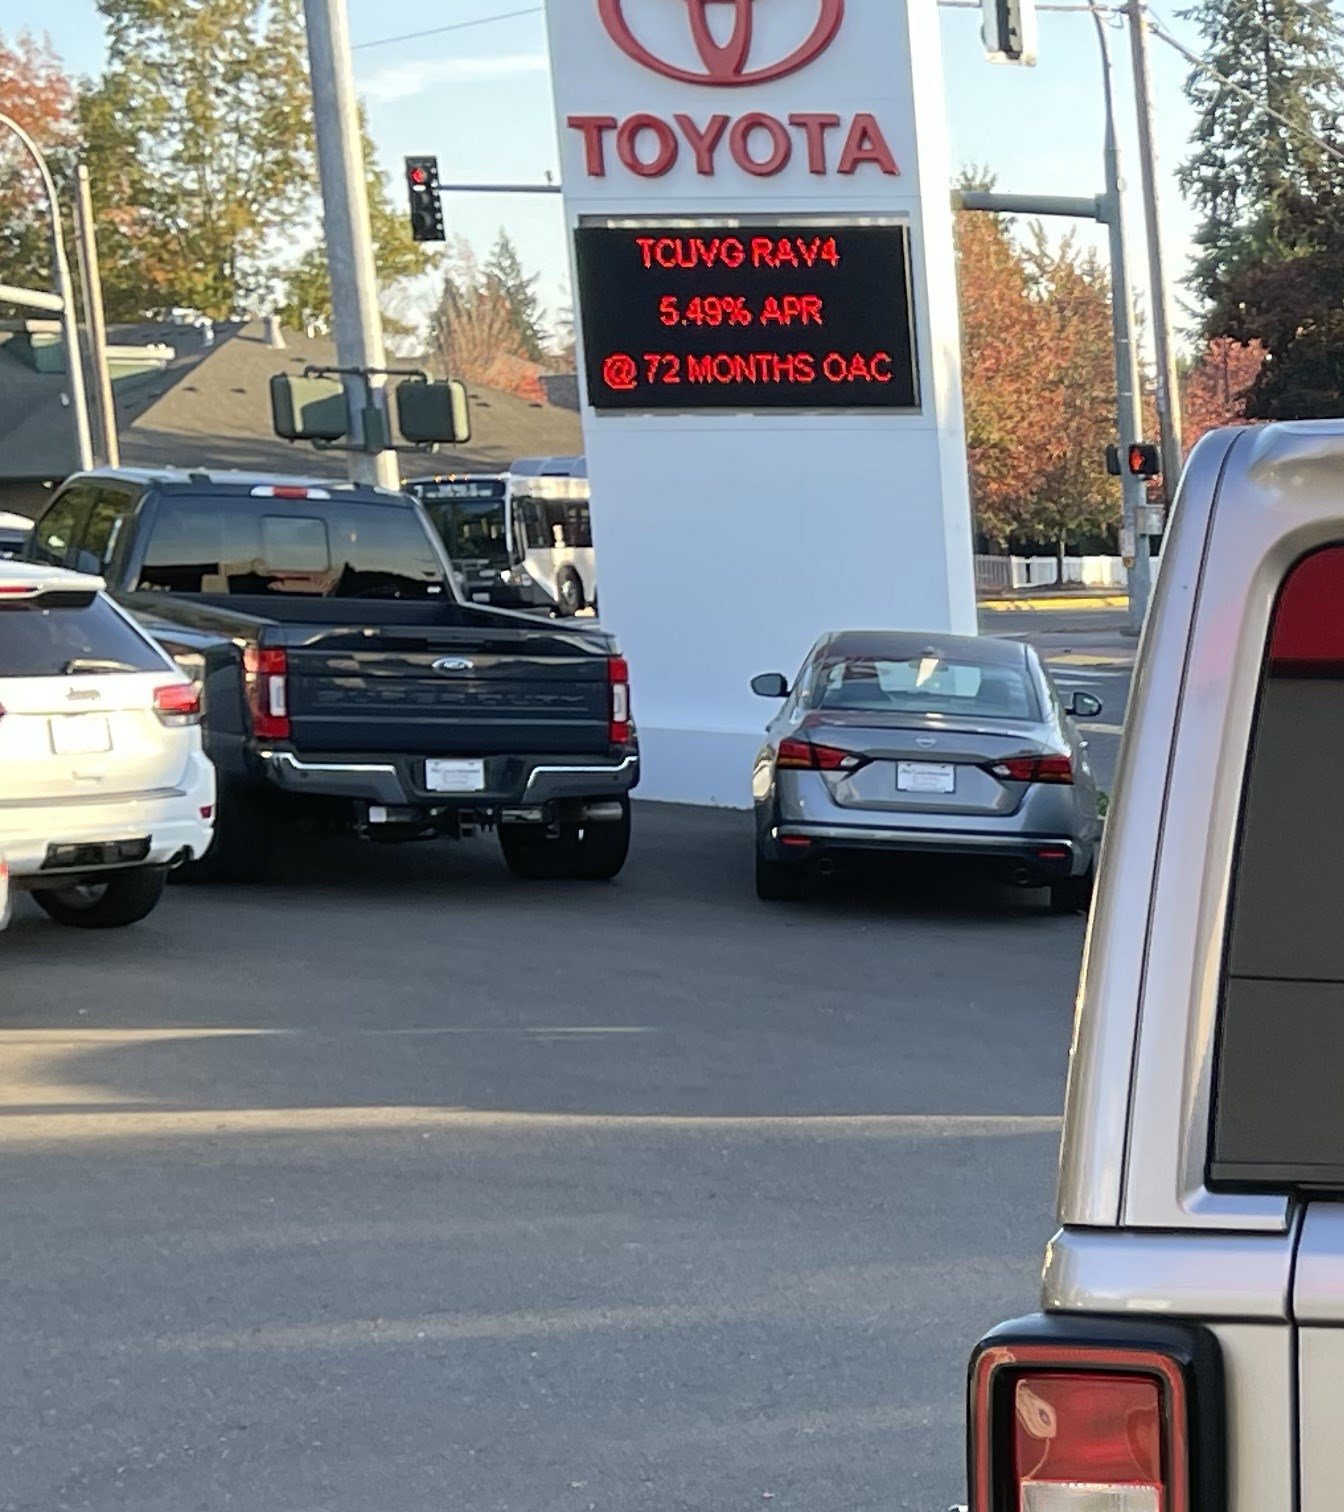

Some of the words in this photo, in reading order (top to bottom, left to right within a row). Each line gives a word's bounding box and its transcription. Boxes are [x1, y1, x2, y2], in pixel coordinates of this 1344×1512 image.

[567, 112, 900, 177] TOYOTA
[635, 236, 744, 269] TCUVG
[749, 236, 840, 269] RAV4
[659, 294, 752, 328] 5.49%
[759, 294, 824, 326] APR
[643, 352, 681, 385] 72
[686, 352, 816, 385] MONTHS
[822, 351, 892, 383] OAC
